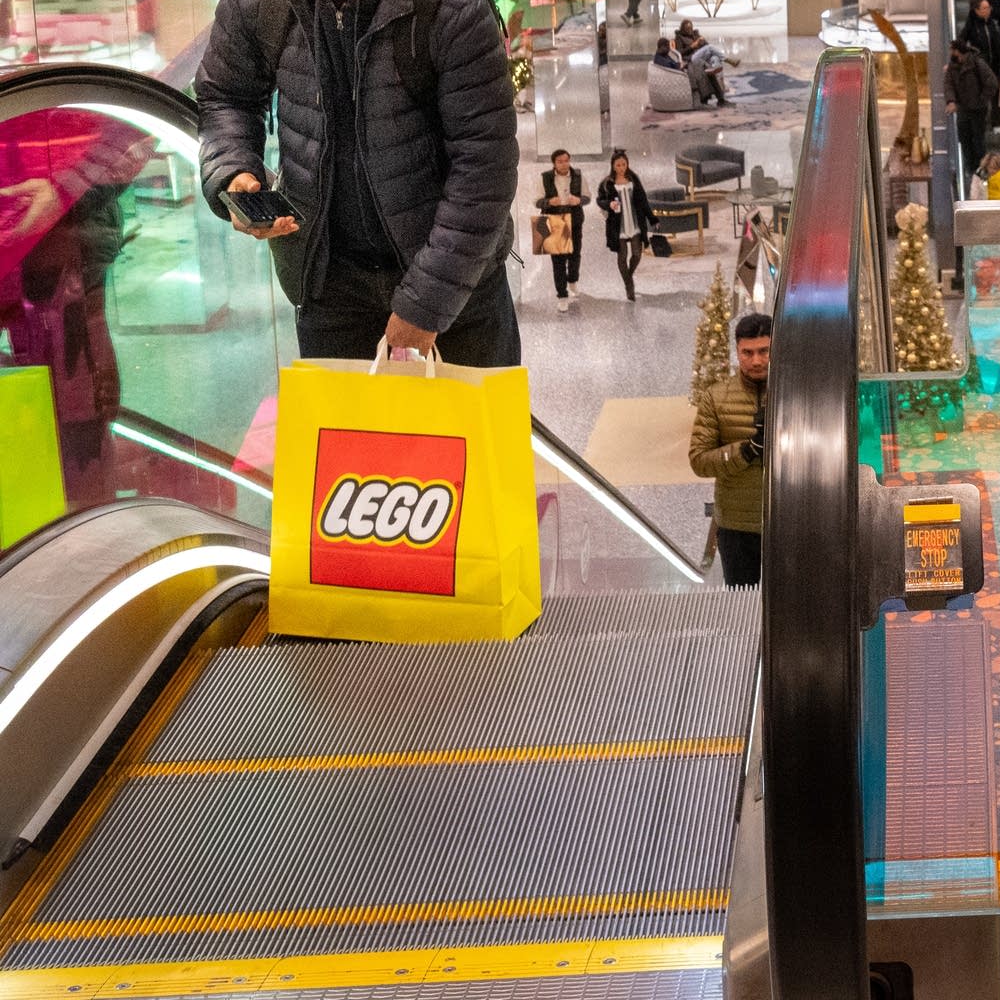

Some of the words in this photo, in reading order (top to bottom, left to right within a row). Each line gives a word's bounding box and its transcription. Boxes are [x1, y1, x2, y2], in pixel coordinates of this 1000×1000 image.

[321, 478, 453, 544] LEGO
[907, 528, 960, 548] EMERGENCY
[920, 548, 947, 568] STOP
[933, 568, 961, 577] COVER
